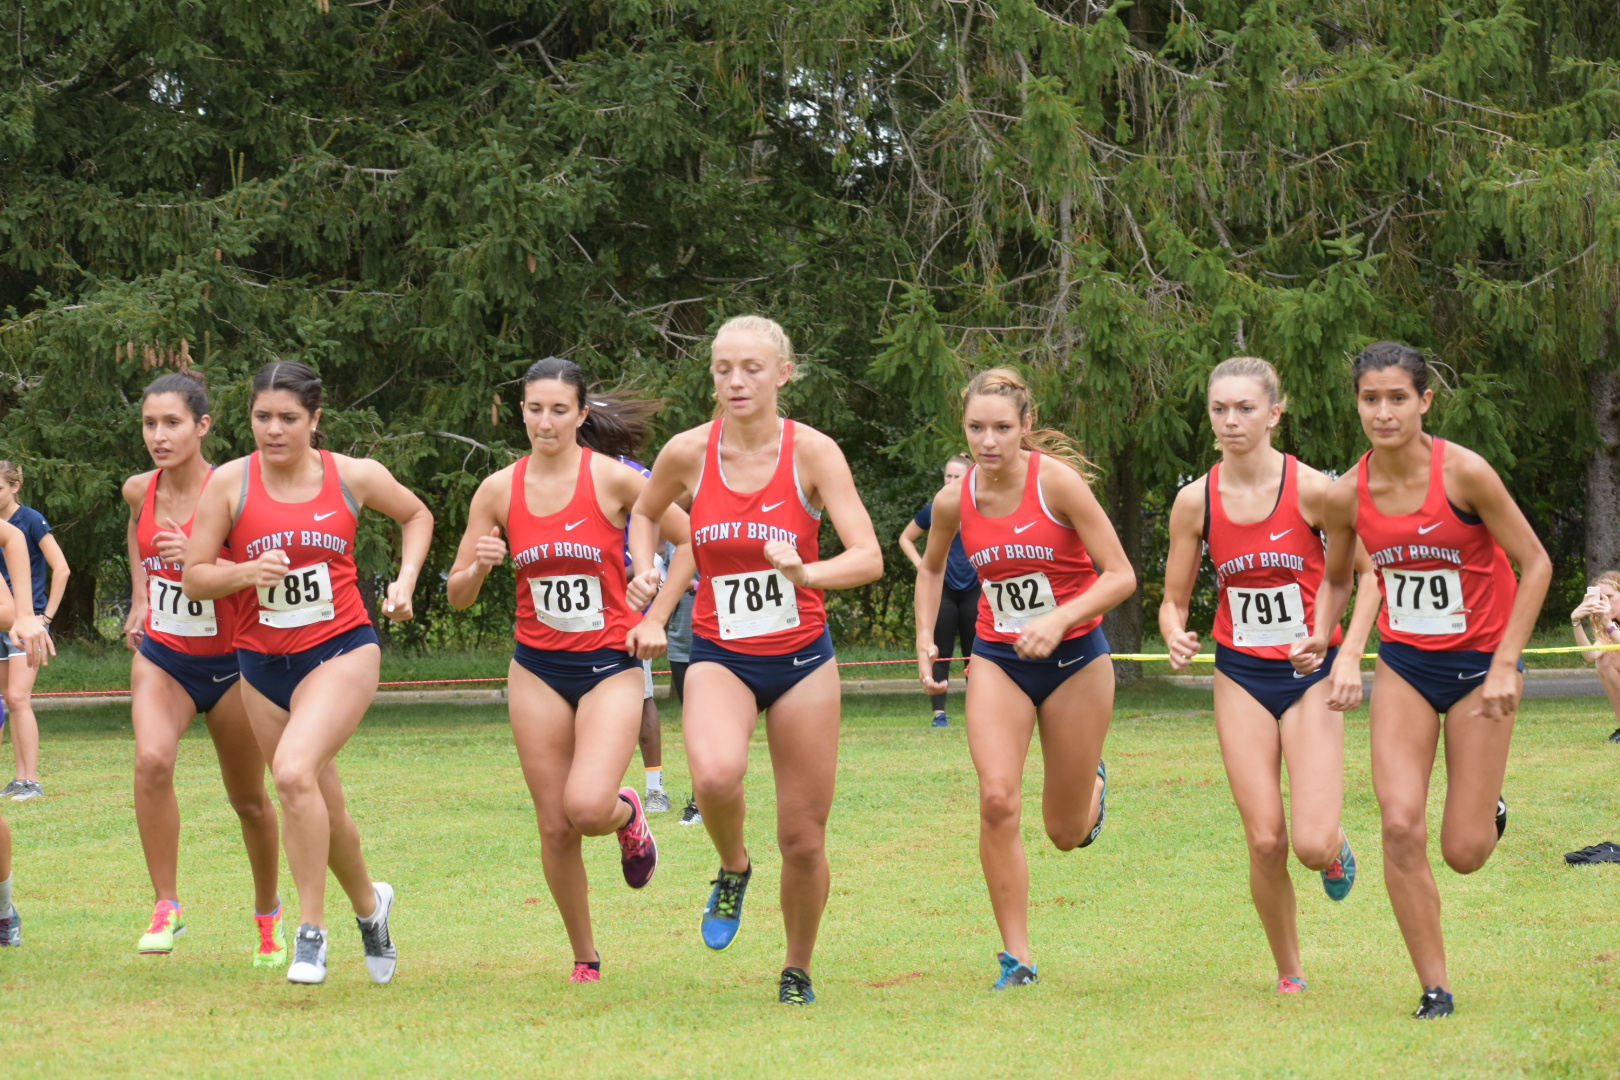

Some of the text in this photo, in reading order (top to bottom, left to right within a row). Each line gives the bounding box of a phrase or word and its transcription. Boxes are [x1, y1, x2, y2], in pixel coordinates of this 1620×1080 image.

[246, 530, 348, 559] STONY BROOK
[695, 521, 799, 550] STONY BROOK
[553, 541, 602, 563] BROOK
[969, 544, 1055, 569] TONY BROOK
[1259, 552, 1305, 572] BROOK
[1370, 544, 1462, 569] TONY BROOK
[539, 578, 590, 612] 783
[724, 573, 784, 614] 784
[990, 578, 1045, 611] 782
[1393, 572, 1449, 610] 779
[1237, 591, 1292, 625] 791
